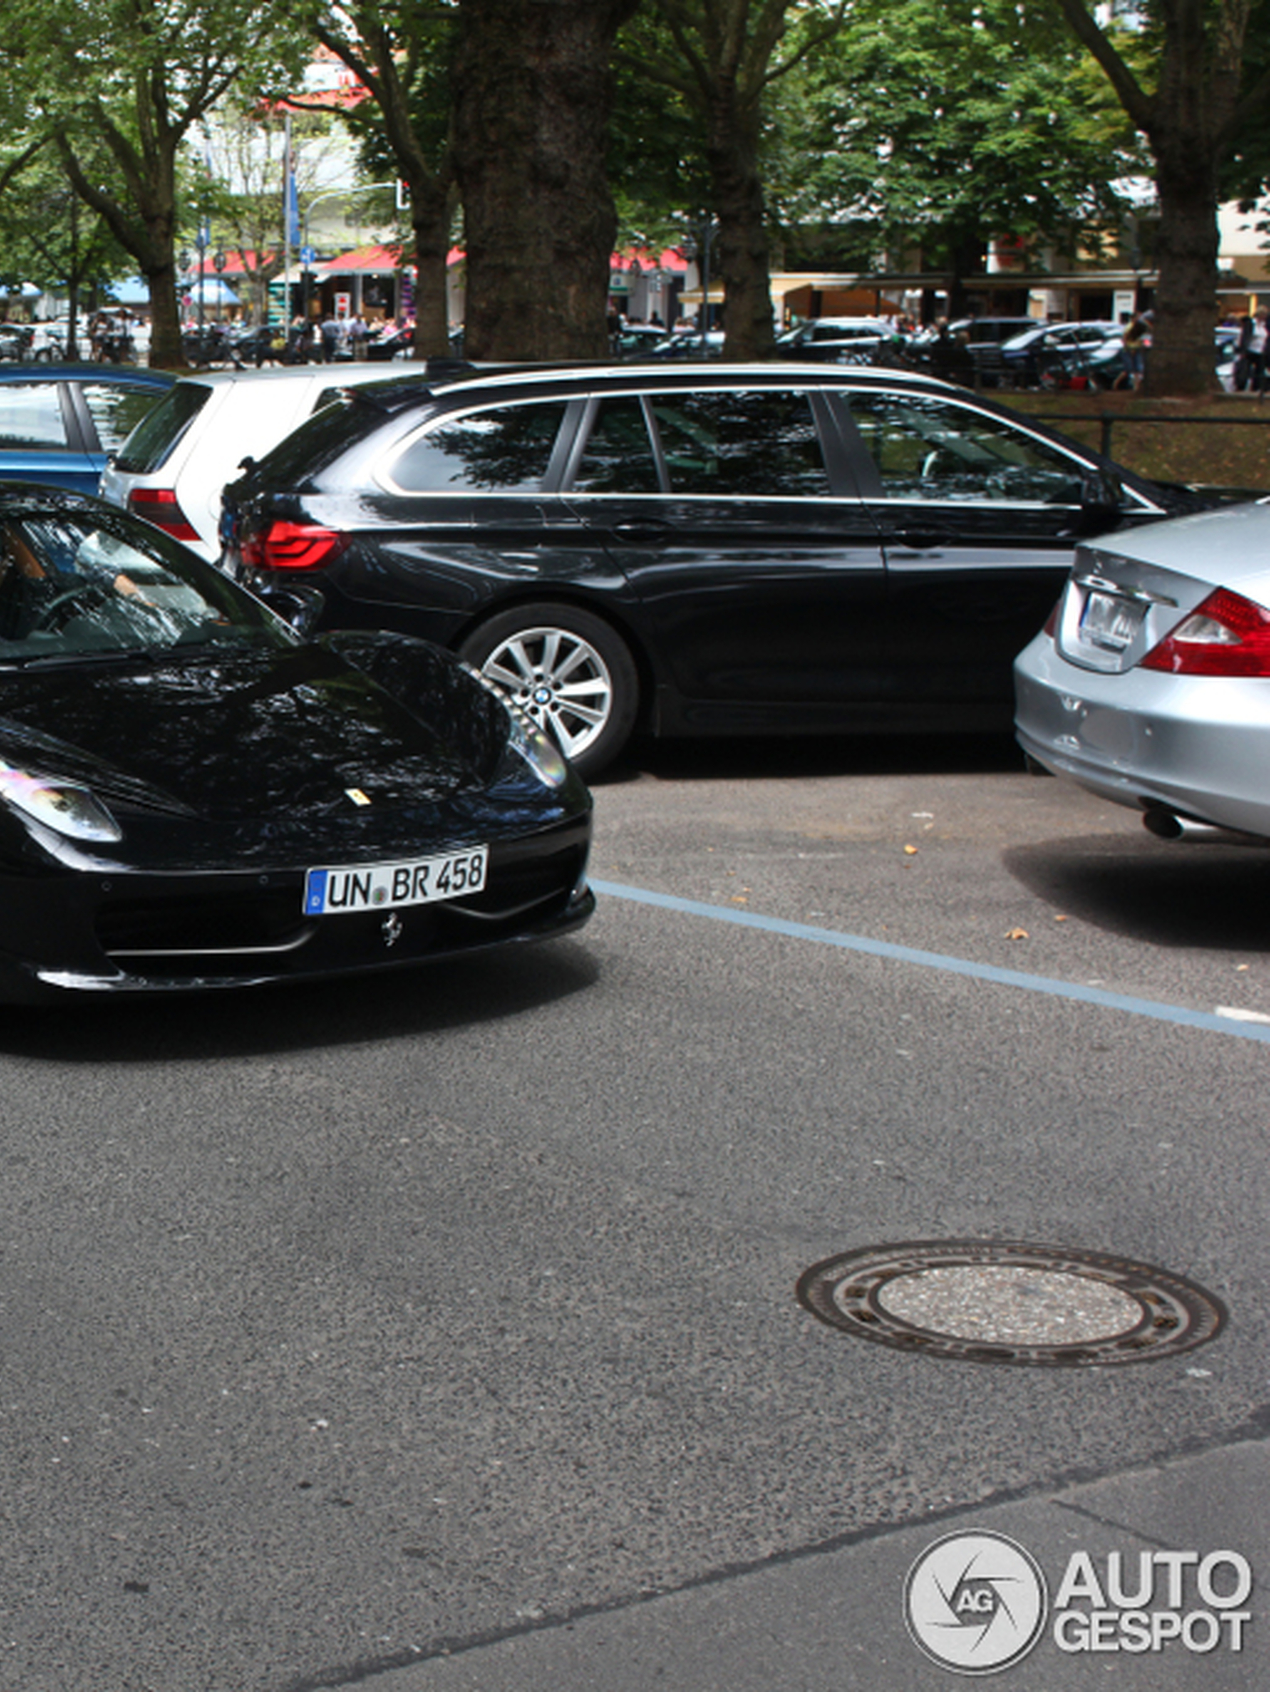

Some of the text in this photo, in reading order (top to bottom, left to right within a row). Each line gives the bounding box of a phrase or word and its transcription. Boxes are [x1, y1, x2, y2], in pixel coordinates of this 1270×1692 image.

[328, 872, 372, 908] UN
[391, 864, 430, 901] BR
[436, 853, 483, 894] 458
